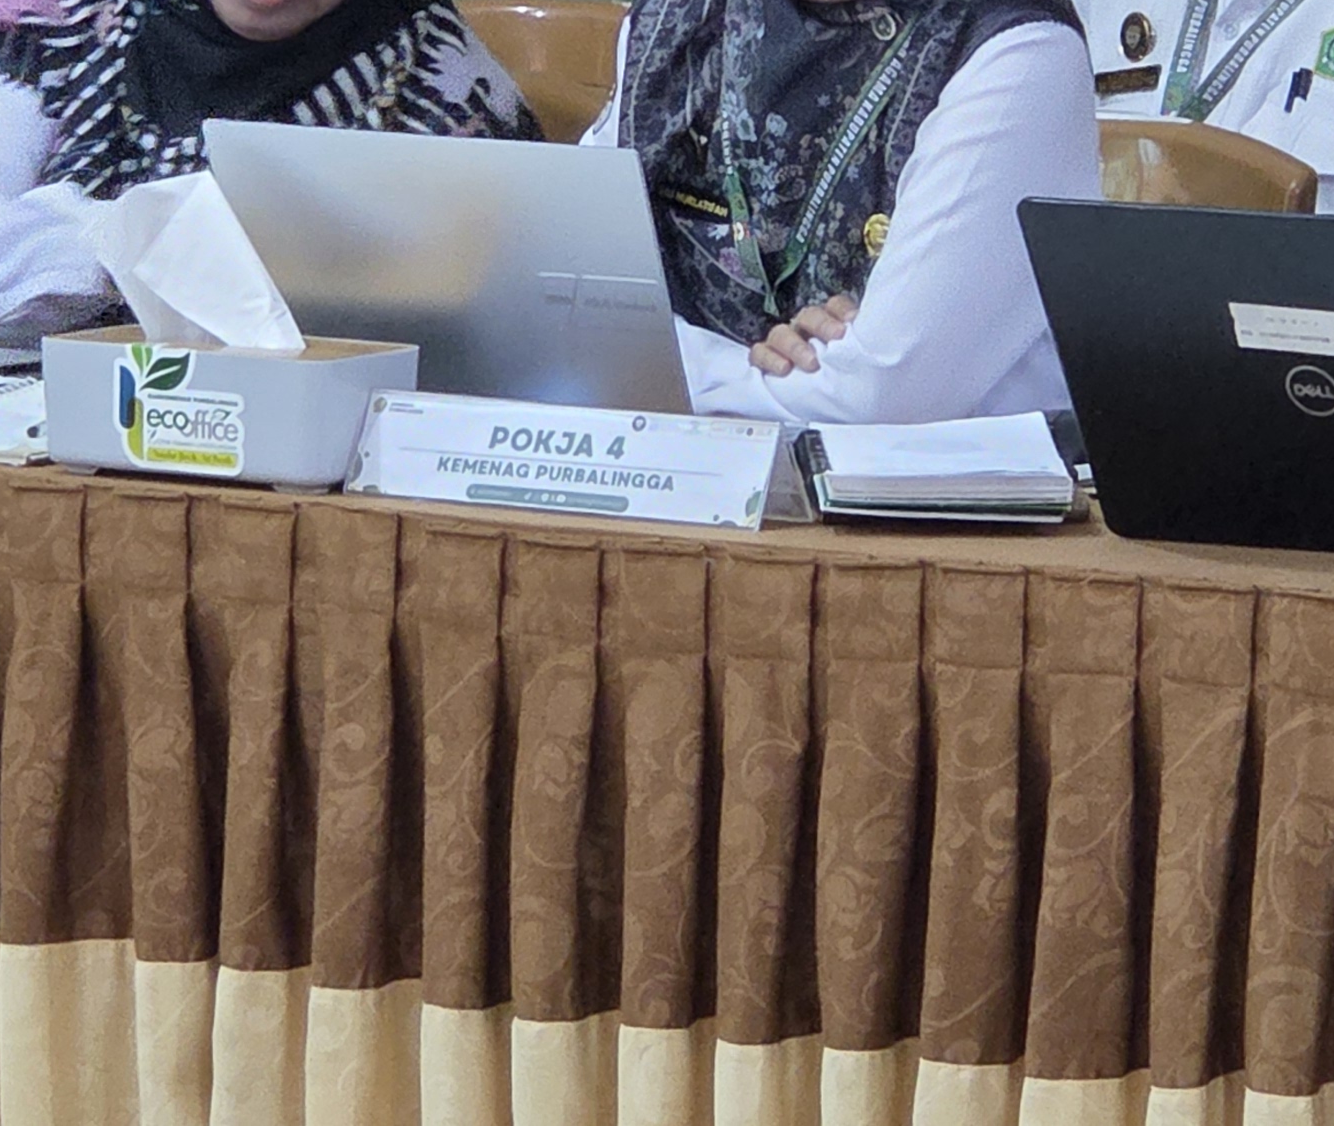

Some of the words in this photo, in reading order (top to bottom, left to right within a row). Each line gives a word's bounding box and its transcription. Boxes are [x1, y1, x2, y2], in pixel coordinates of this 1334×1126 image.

[867, 57, 903, 102] AGAMA
[830, 99, 873, 166] KABUPATEN
[488, 425, 593, 458] POKJA
[606, 436, 626, 460] 4
[436, 456, 530, 479] KEMENAG
[535, 464, 675, 492] PURBALINGGA
